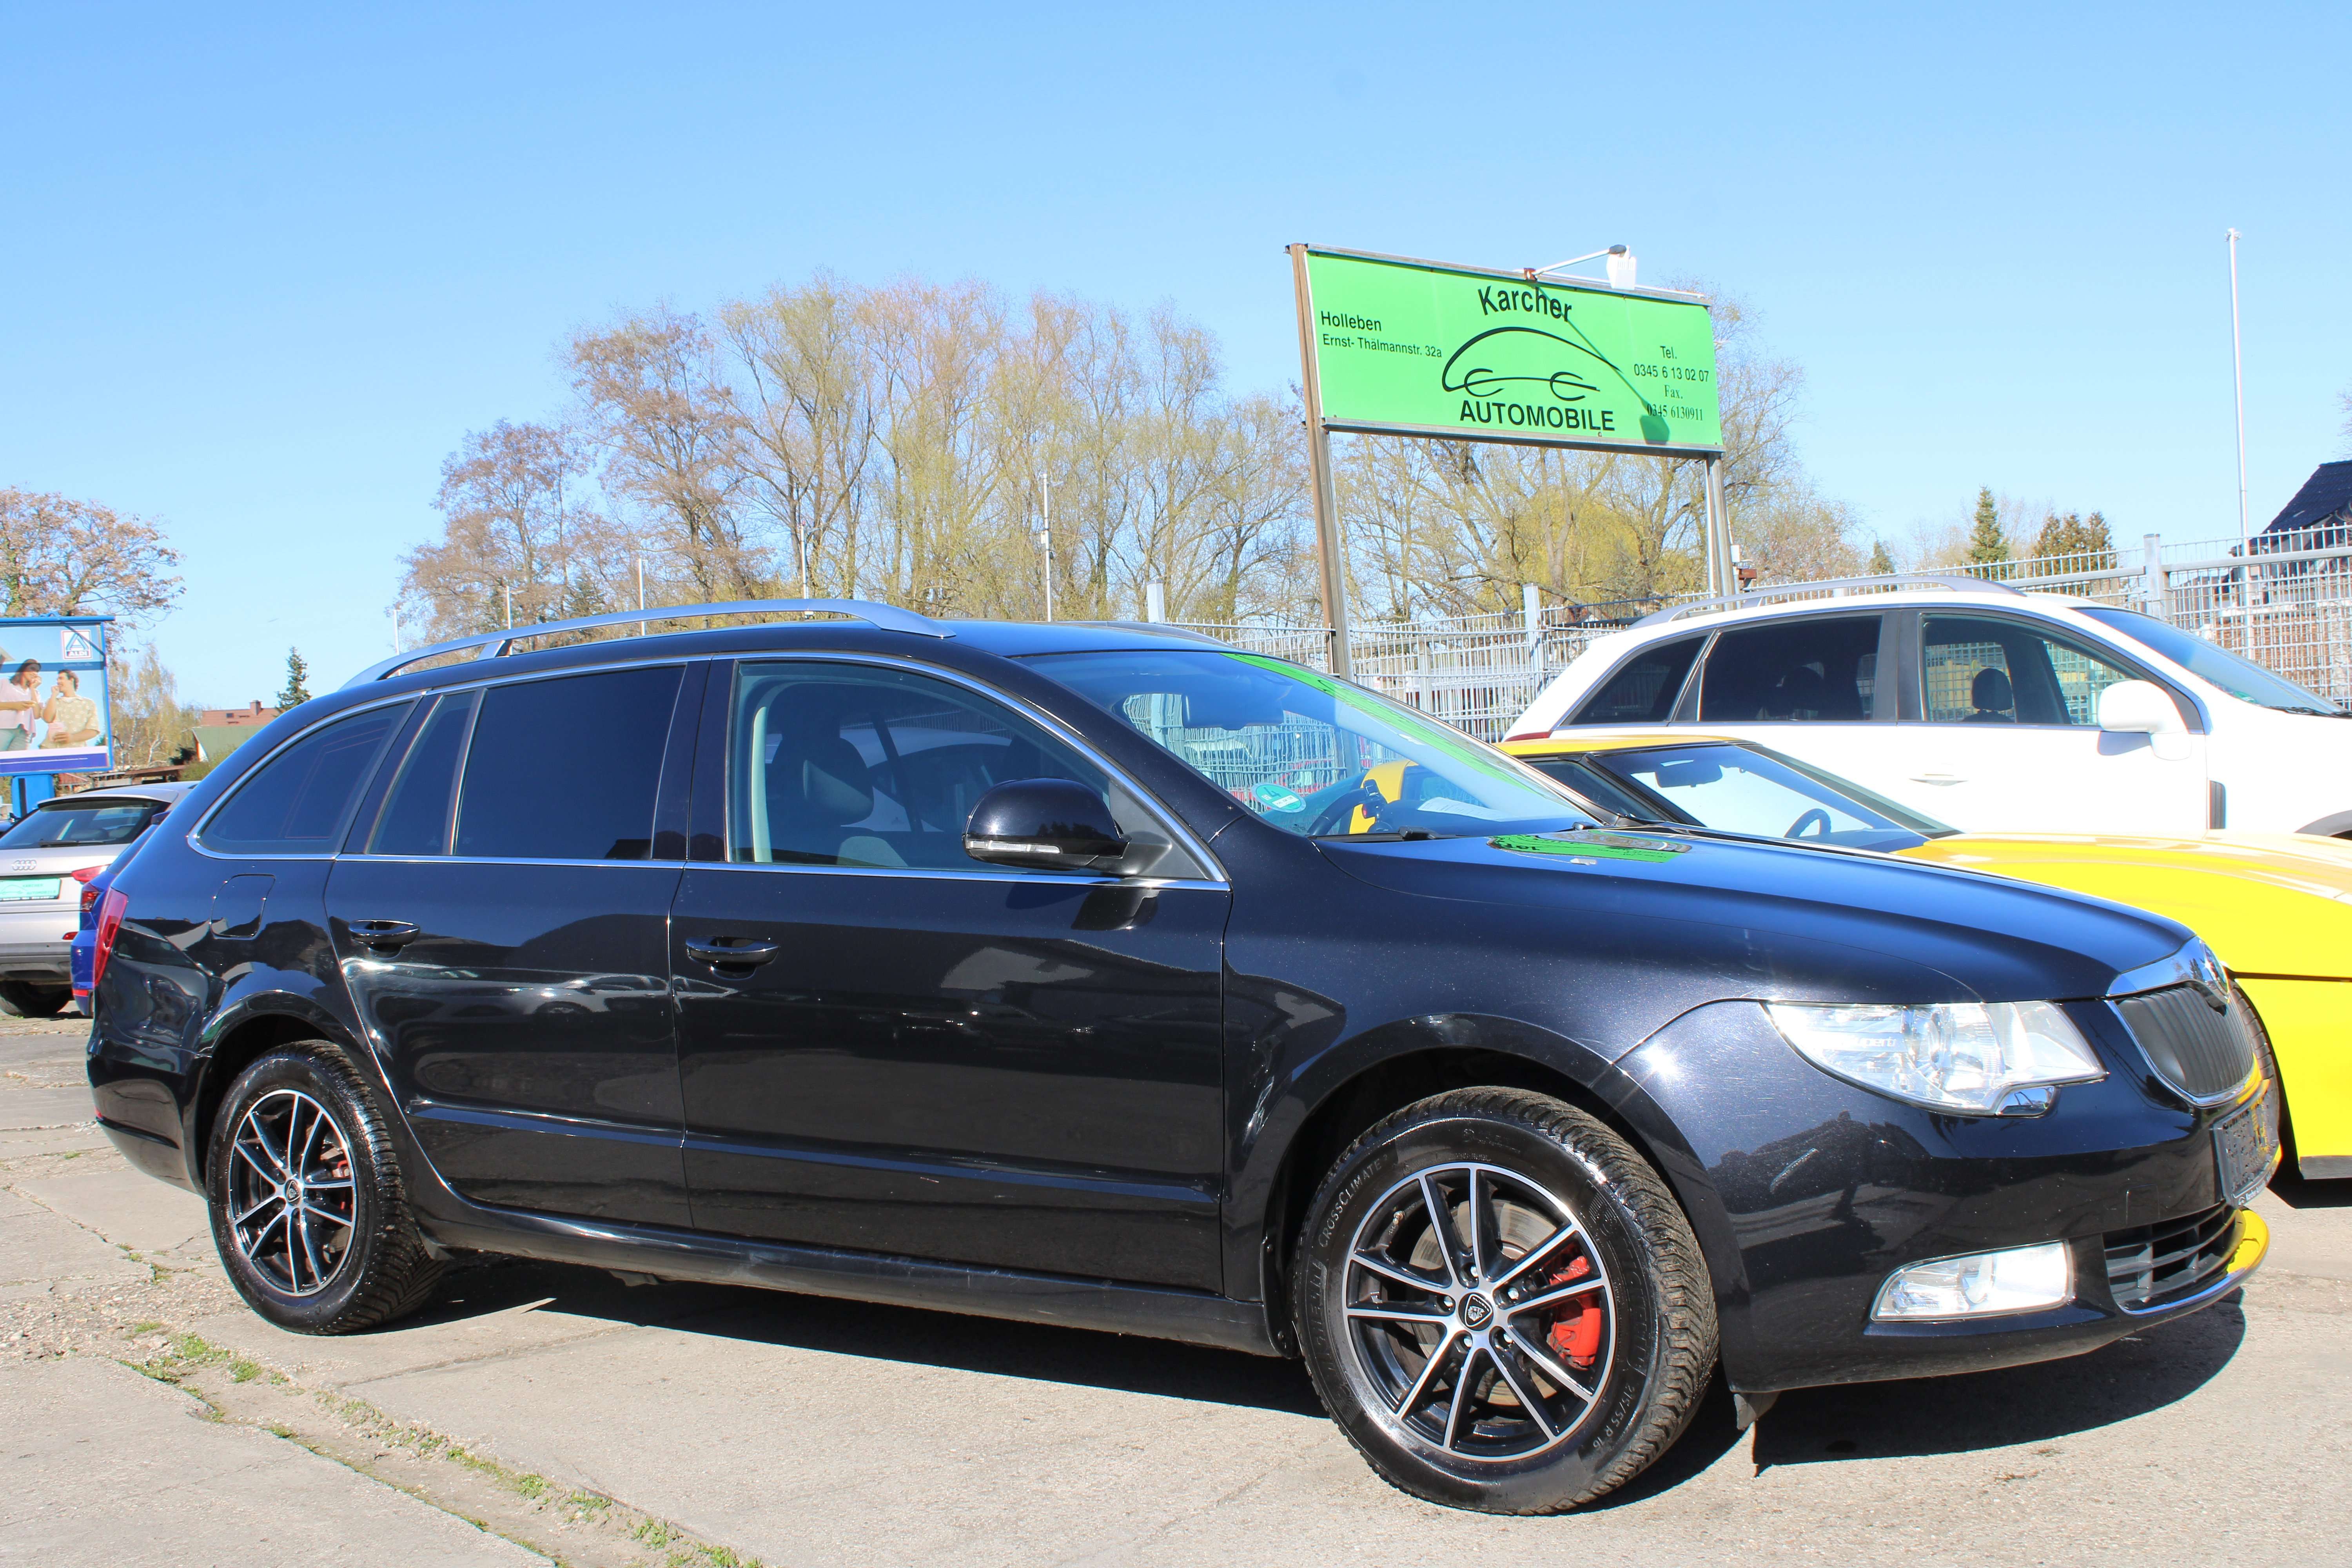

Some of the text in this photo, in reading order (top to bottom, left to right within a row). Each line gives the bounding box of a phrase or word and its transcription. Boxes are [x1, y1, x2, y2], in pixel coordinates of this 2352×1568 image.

[1478, 285, 1572, 322] Karcher
[1321, 310, 1382, 331] Holleben
[1323, 334, 1442, 358] Ernst- Thälmannstr. 32a
[1660, 346, 1677, 359] Tel.
[1634, 364, 1709, 382] 0345 6 13 02 07
[1664, 385, 1683, 399] Fax.
[1460, 400, 1615, 431] AUTOMOBILE
[1647, 403, 1703, 421] 0345 6130911
